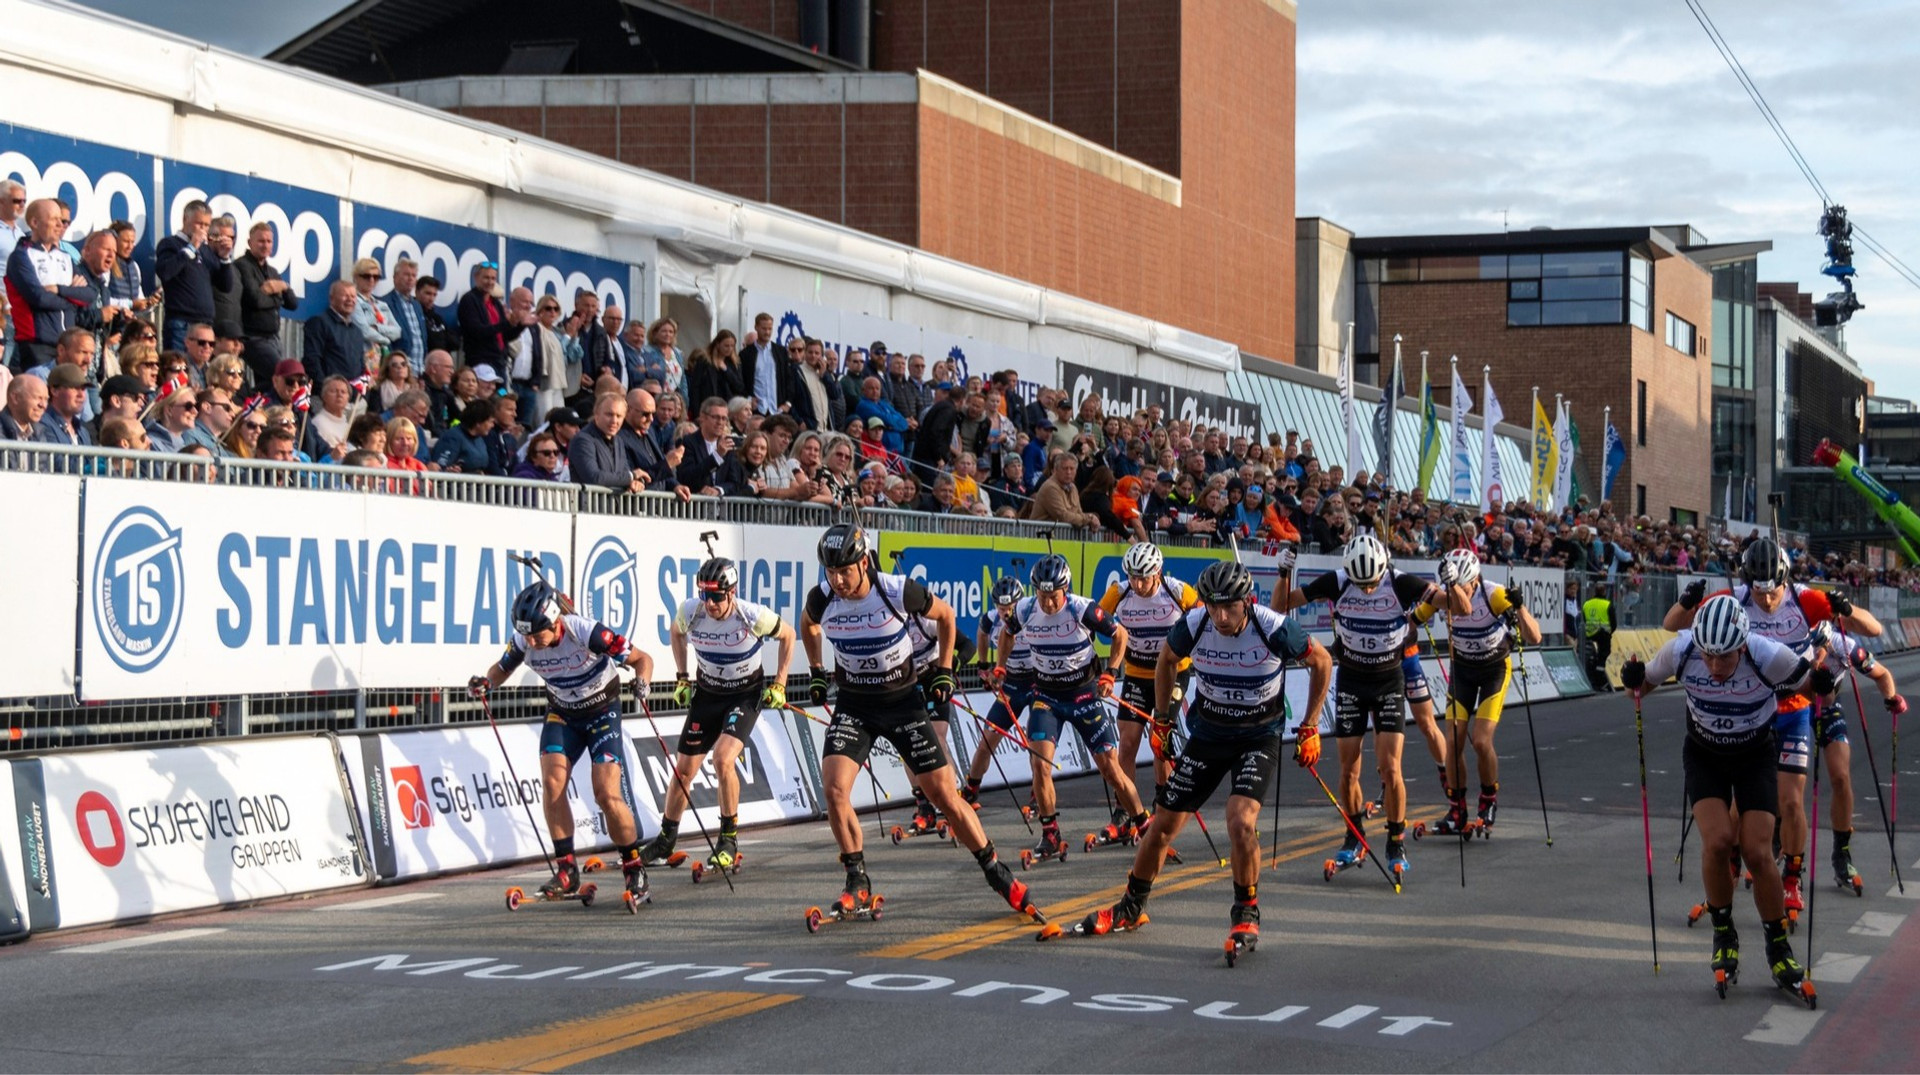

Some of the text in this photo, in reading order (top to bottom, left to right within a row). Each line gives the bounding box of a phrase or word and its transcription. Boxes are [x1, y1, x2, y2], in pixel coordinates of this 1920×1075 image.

[0, 151, 146, 248] oop
[170, 187, 334, 298] coop
[1073, 374, 1164, 424] ØterHs
[828, 613, 874, 625] sport
[1750, 620, 1783, 630] port
[1143, 640, 1160, 650] 27
[1360, 638, 1376, 649] 15
[1465, 641, 1481, 650] 23
[1196, 647, 1246, 660] sport
[716, 666, 725, 675] 7
[857, 657, 878, 670] 29
[1048, 660, 1065, 671] 32
[1223, 690, 1244, 701] 16
[1073, 700, 1102, 717] ASKO
[1711, 718, 1734, 730] 40
[431, 771, 578, 822] Sig.Halvorn
[375, 765, 389, 847] SANDNESLAUGET
[128, 794, 291, 848] SKJÆVELAND
[25, 814, 40, 879] MEDLEM AV
[32, 801, 51, 899] SANDNESLAUGET
[231, 839, 302, 869] GRUPPEN
[312, 953, 1454, 1036] Multiconsult
